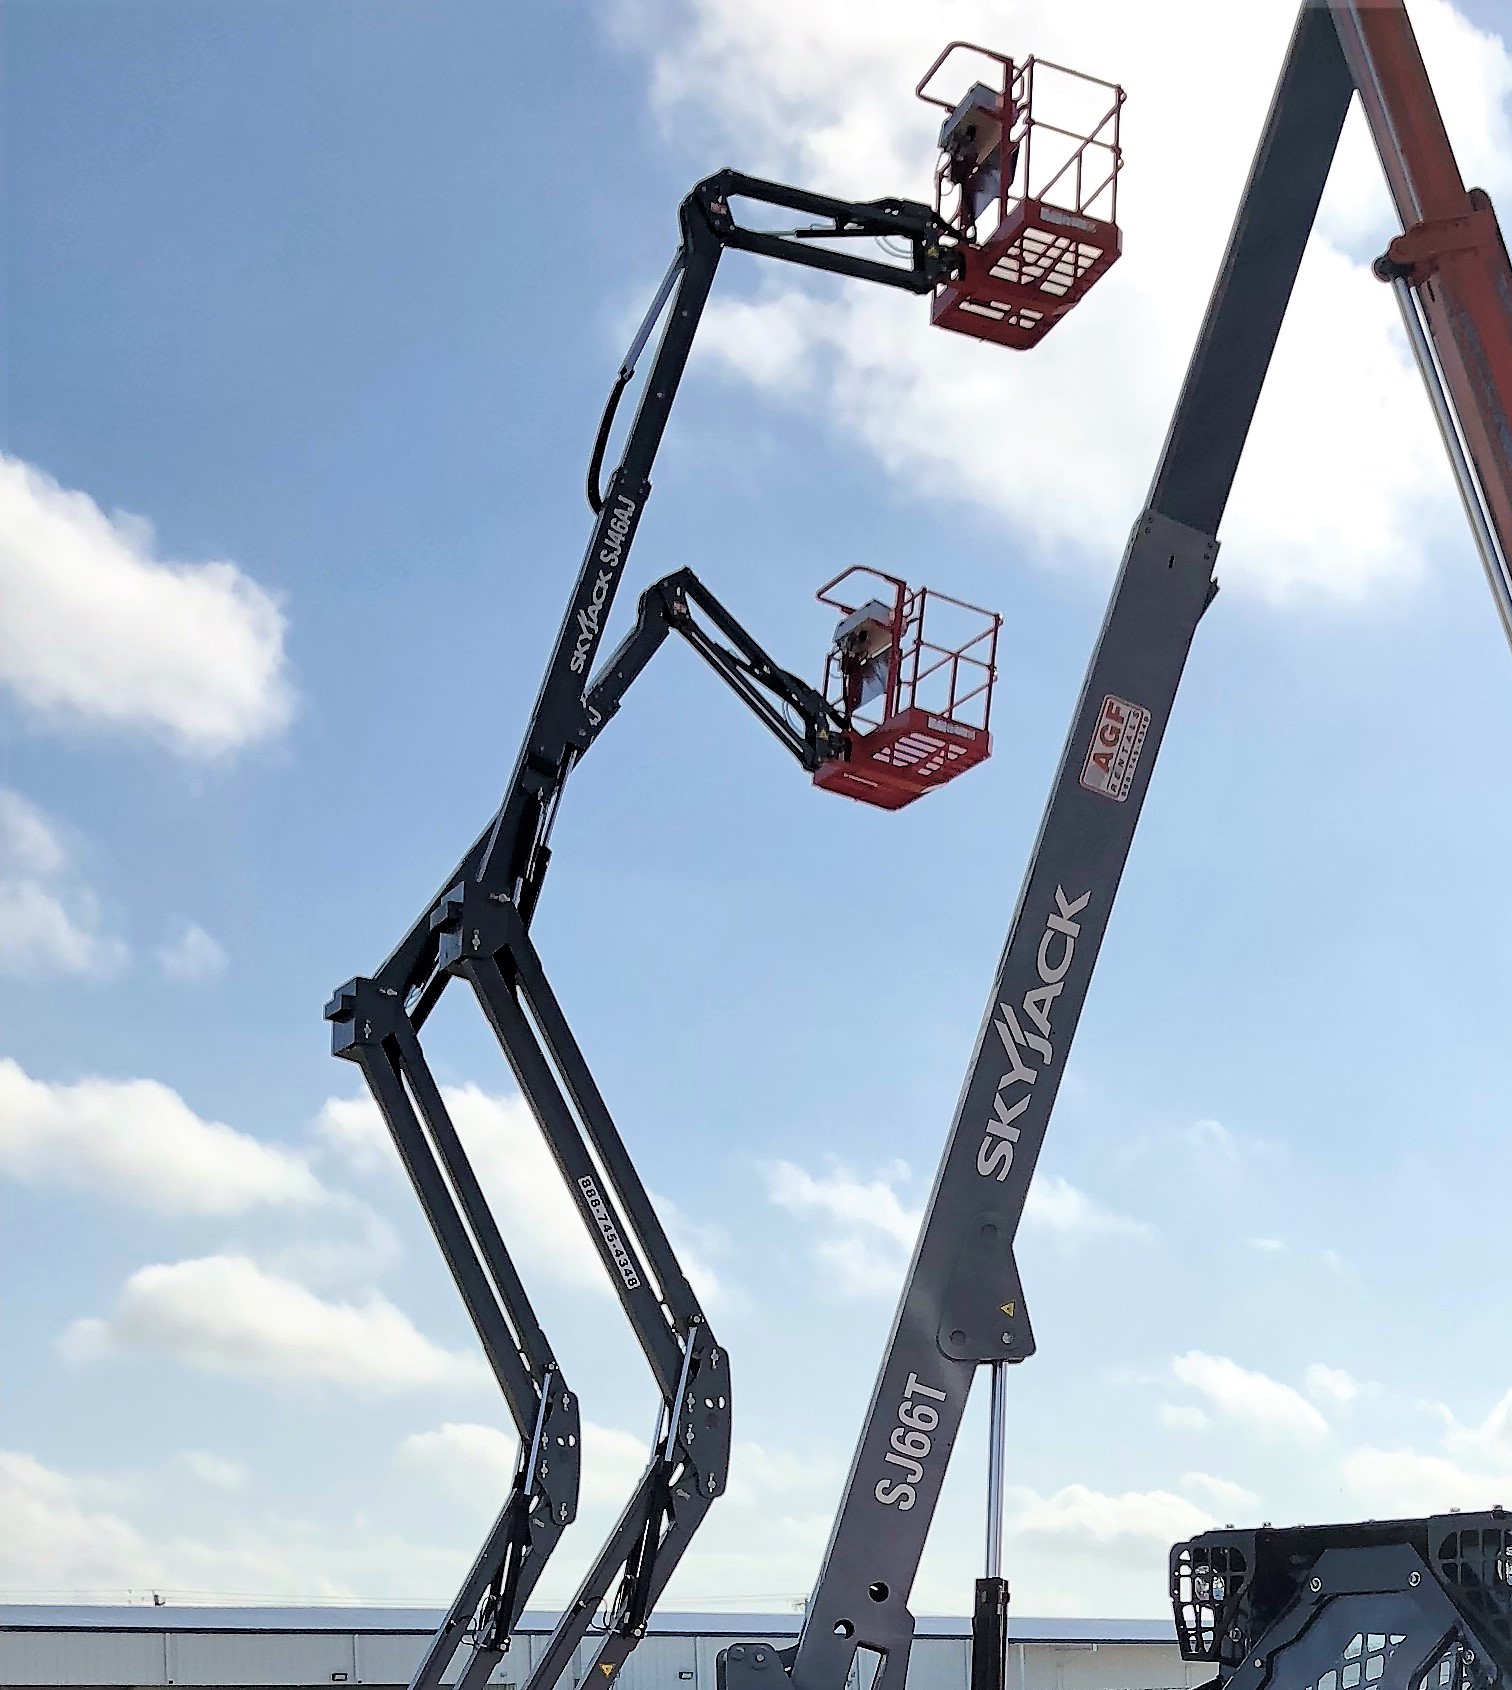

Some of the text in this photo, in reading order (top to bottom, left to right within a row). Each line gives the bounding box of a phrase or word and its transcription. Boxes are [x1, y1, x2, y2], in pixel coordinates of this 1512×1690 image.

[569, 494, 636, 674] SKYJACK SJ46AJ
[1093, 701, 1125, 774] AGF
[1110, 710, 1140, 793] RENTALS
[975, 884, 1092, 1182] SKYJACK
[581, 1178, 638, 1287] 888-745-4348
[874, 1371, 947, 1511] SJ66T
